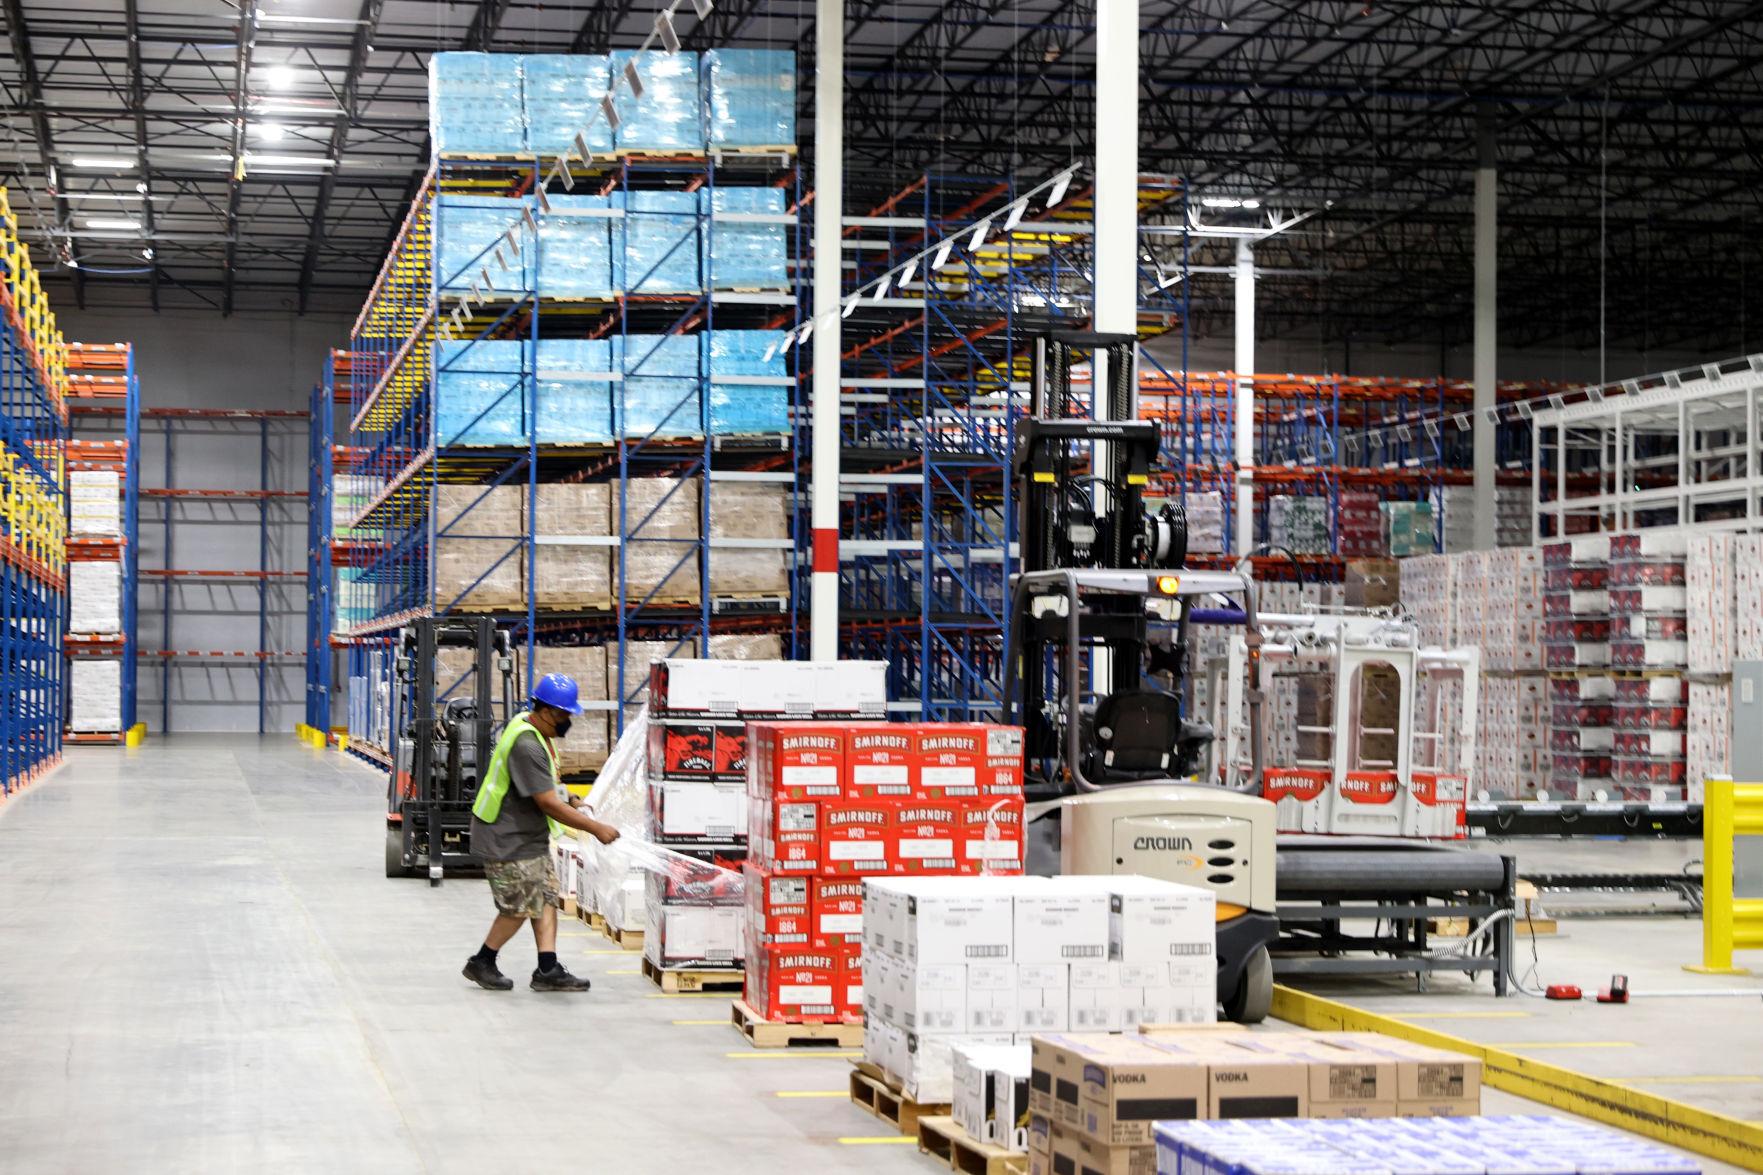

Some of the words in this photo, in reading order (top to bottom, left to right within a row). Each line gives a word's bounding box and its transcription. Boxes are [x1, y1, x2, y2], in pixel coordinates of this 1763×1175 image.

[783, 736, 836, 749] SMIRNOFF
[855, 736, 907, 749] SMIRNOFF
[922, 737, 974, 750] SMIRNOFF
[1270, 776, 1314, 789] SMIRNOFF
[830, 811, 883, 824] SMIRNOFF
[900, 809, 952, 822] SMIRNOFF
[820, 884, 862, 897] SMIRNO
[779, 956, 832, 969] SMIRNOFF
[1112, 1073, 1146, 1083] VODKA
[1215, 1072, 1248, 1082] VODKA
